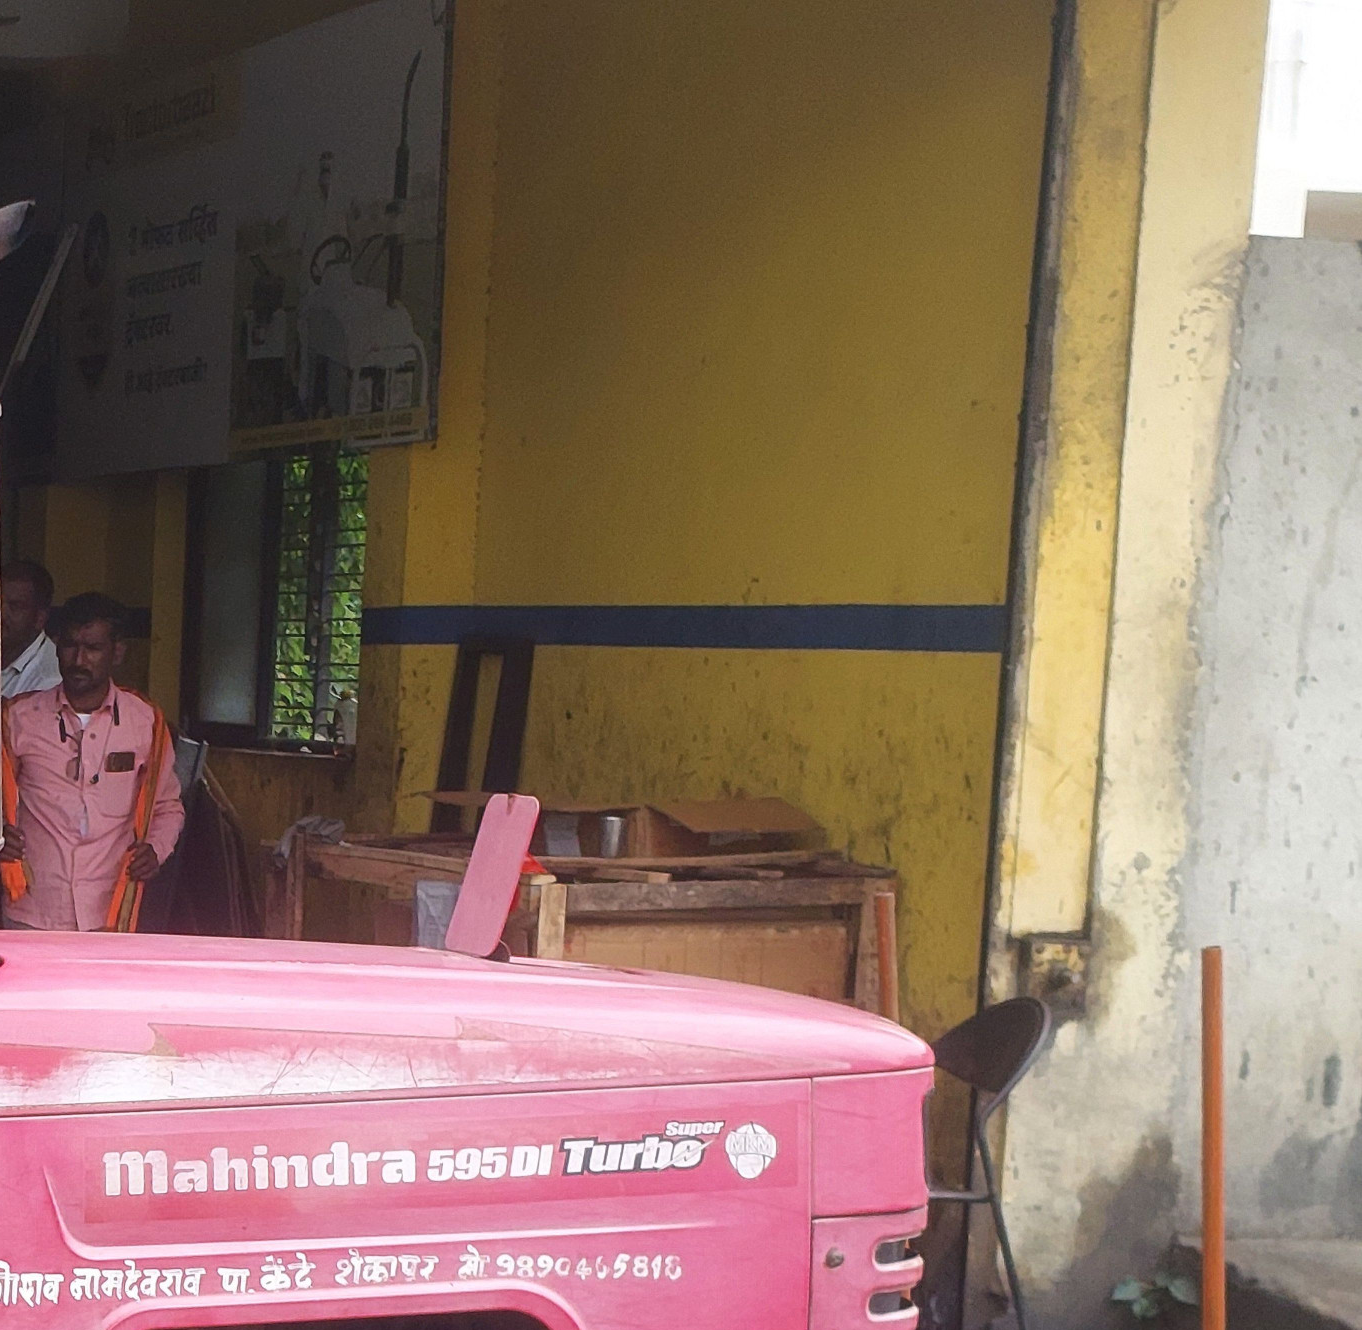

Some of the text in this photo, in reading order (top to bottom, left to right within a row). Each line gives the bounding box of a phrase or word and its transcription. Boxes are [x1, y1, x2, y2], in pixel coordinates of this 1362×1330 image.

[666, 1120, 725, 1137] Super
[102, 1141, 417, 1197] Mahindra
[563, 1134, 708, 1177] Turbo
[69, 1259, 206, 1302] नामदेवराव
